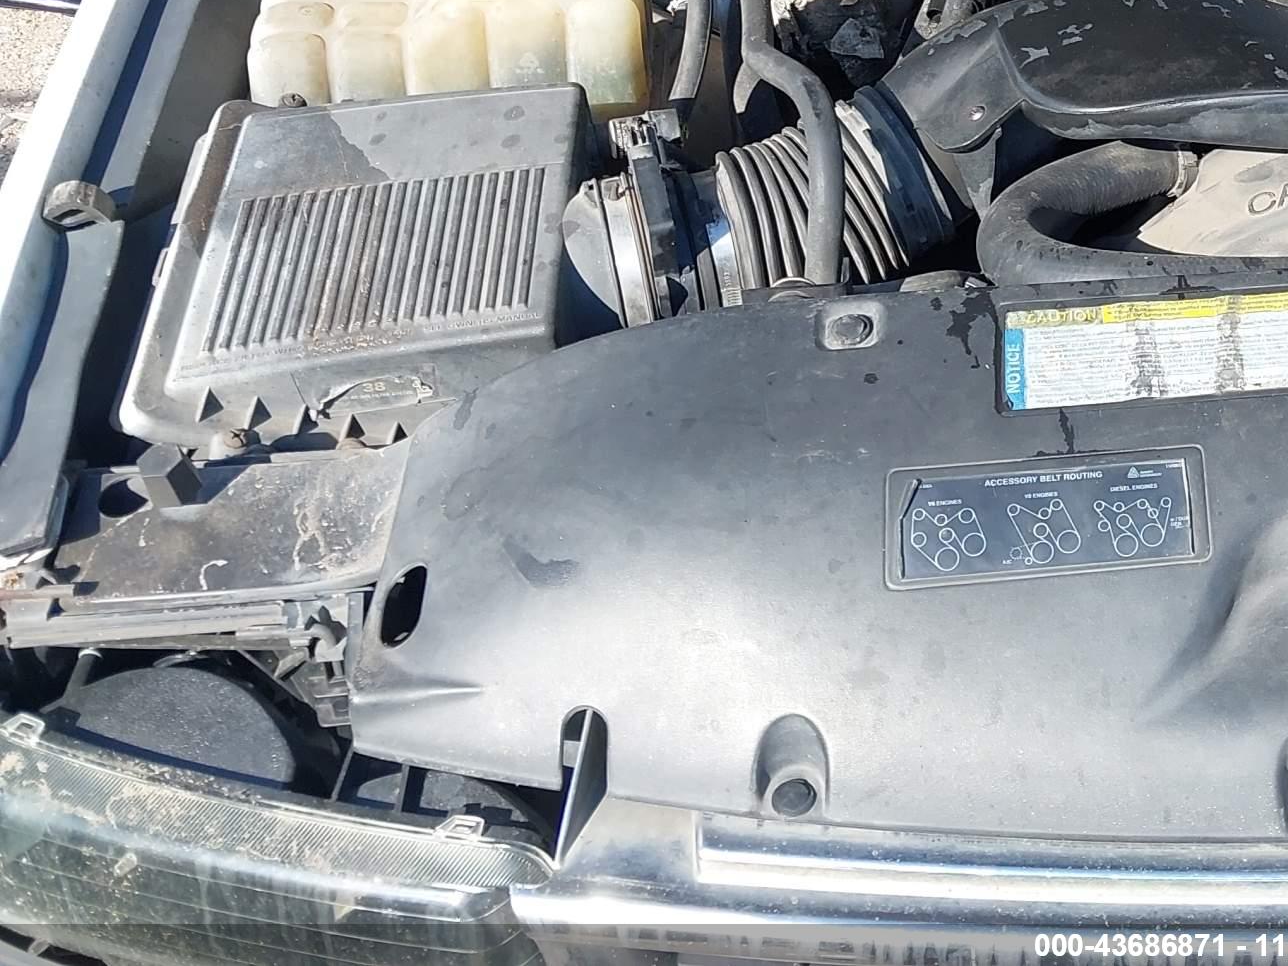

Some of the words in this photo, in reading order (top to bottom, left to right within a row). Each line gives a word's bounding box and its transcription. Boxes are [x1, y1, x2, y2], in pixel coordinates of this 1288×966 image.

[1026, 309, 1098, 324] CAUTION
[1006, 343, 1021, 394] NOTICE
[362, 382, 386, 393] 38
[984, 475, 1038, 487] ACCESSORY
[1039, 473, 1062, 483] BELT
[1063, 470, 1103, 481] ROUTING
